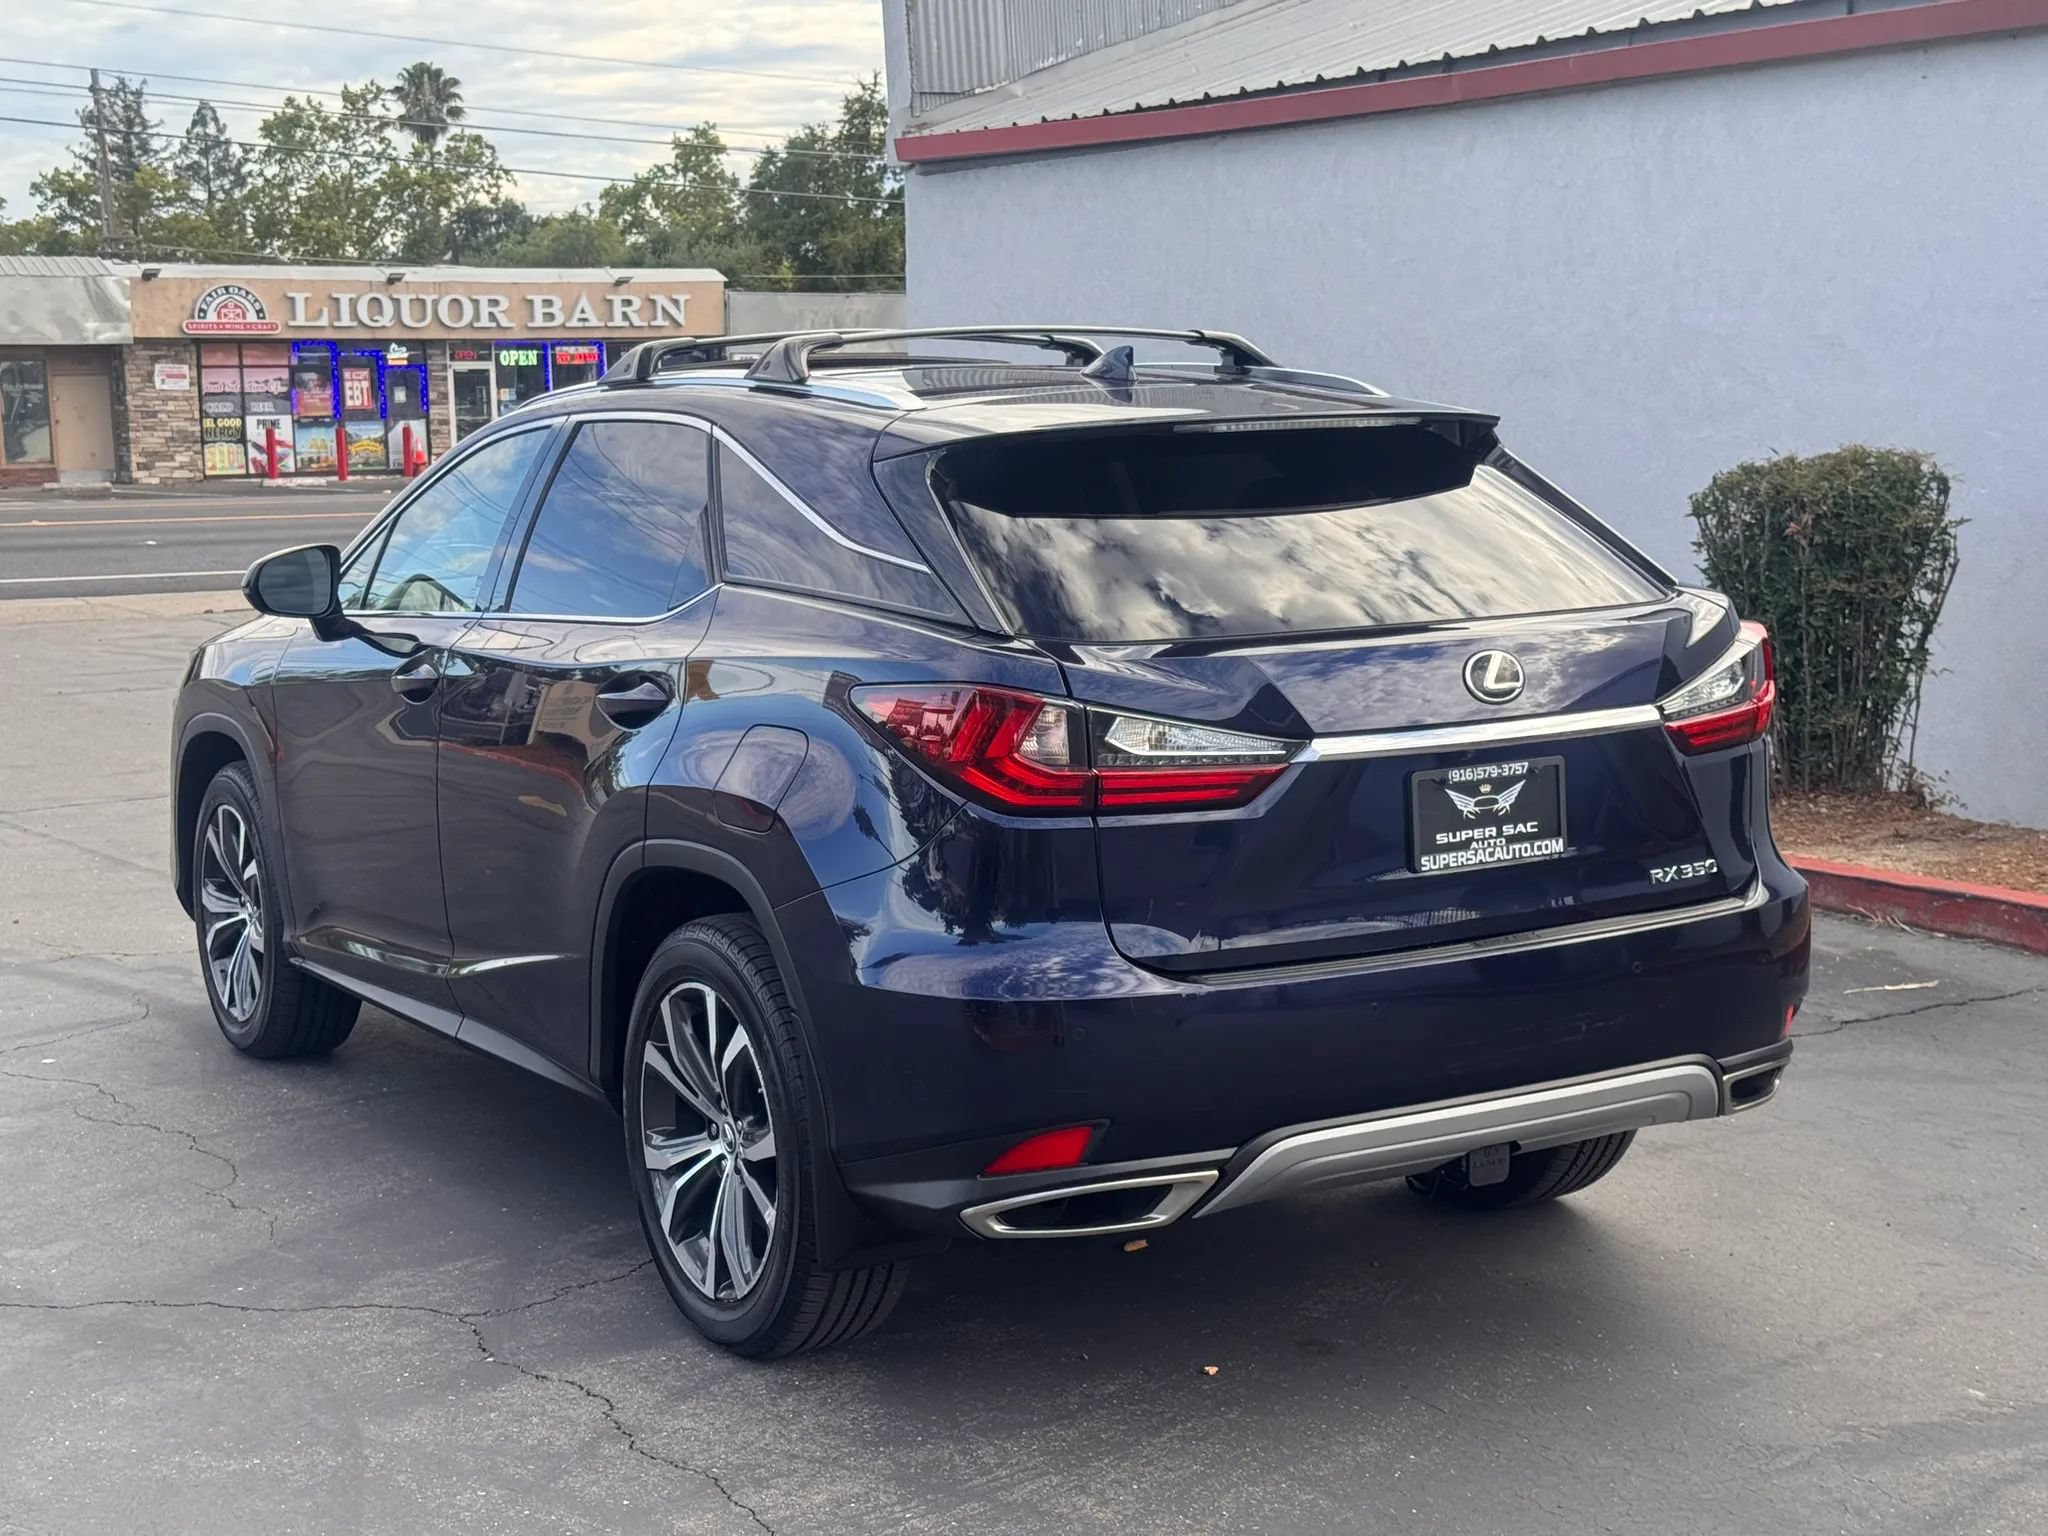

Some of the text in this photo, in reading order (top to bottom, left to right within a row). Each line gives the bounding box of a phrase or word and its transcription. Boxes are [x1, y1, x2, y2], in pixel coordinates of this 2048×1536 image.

[201, 286, 263, 310] FAIR OAKS
[287, 291, 690, 329] LIQUOR BARN
[455, 350, 478, 361] OPEN
[499, 350, 538, 366] OPEN
[344, 380, 369, 406] EBT
[217, 418, 242, 428] GOOD
[256, 418, 281, 430] PRIME
[1448, 762, 1529, 784] (916)579-3757
[1436, 821, 1538, 845] SUPER SAC
[1470, 838, 1506, 850] AUTO
[1420, 838, 1564, 872] SUPERSACAUTO.COM
[1649, 859, 1718, 885] RX 350
